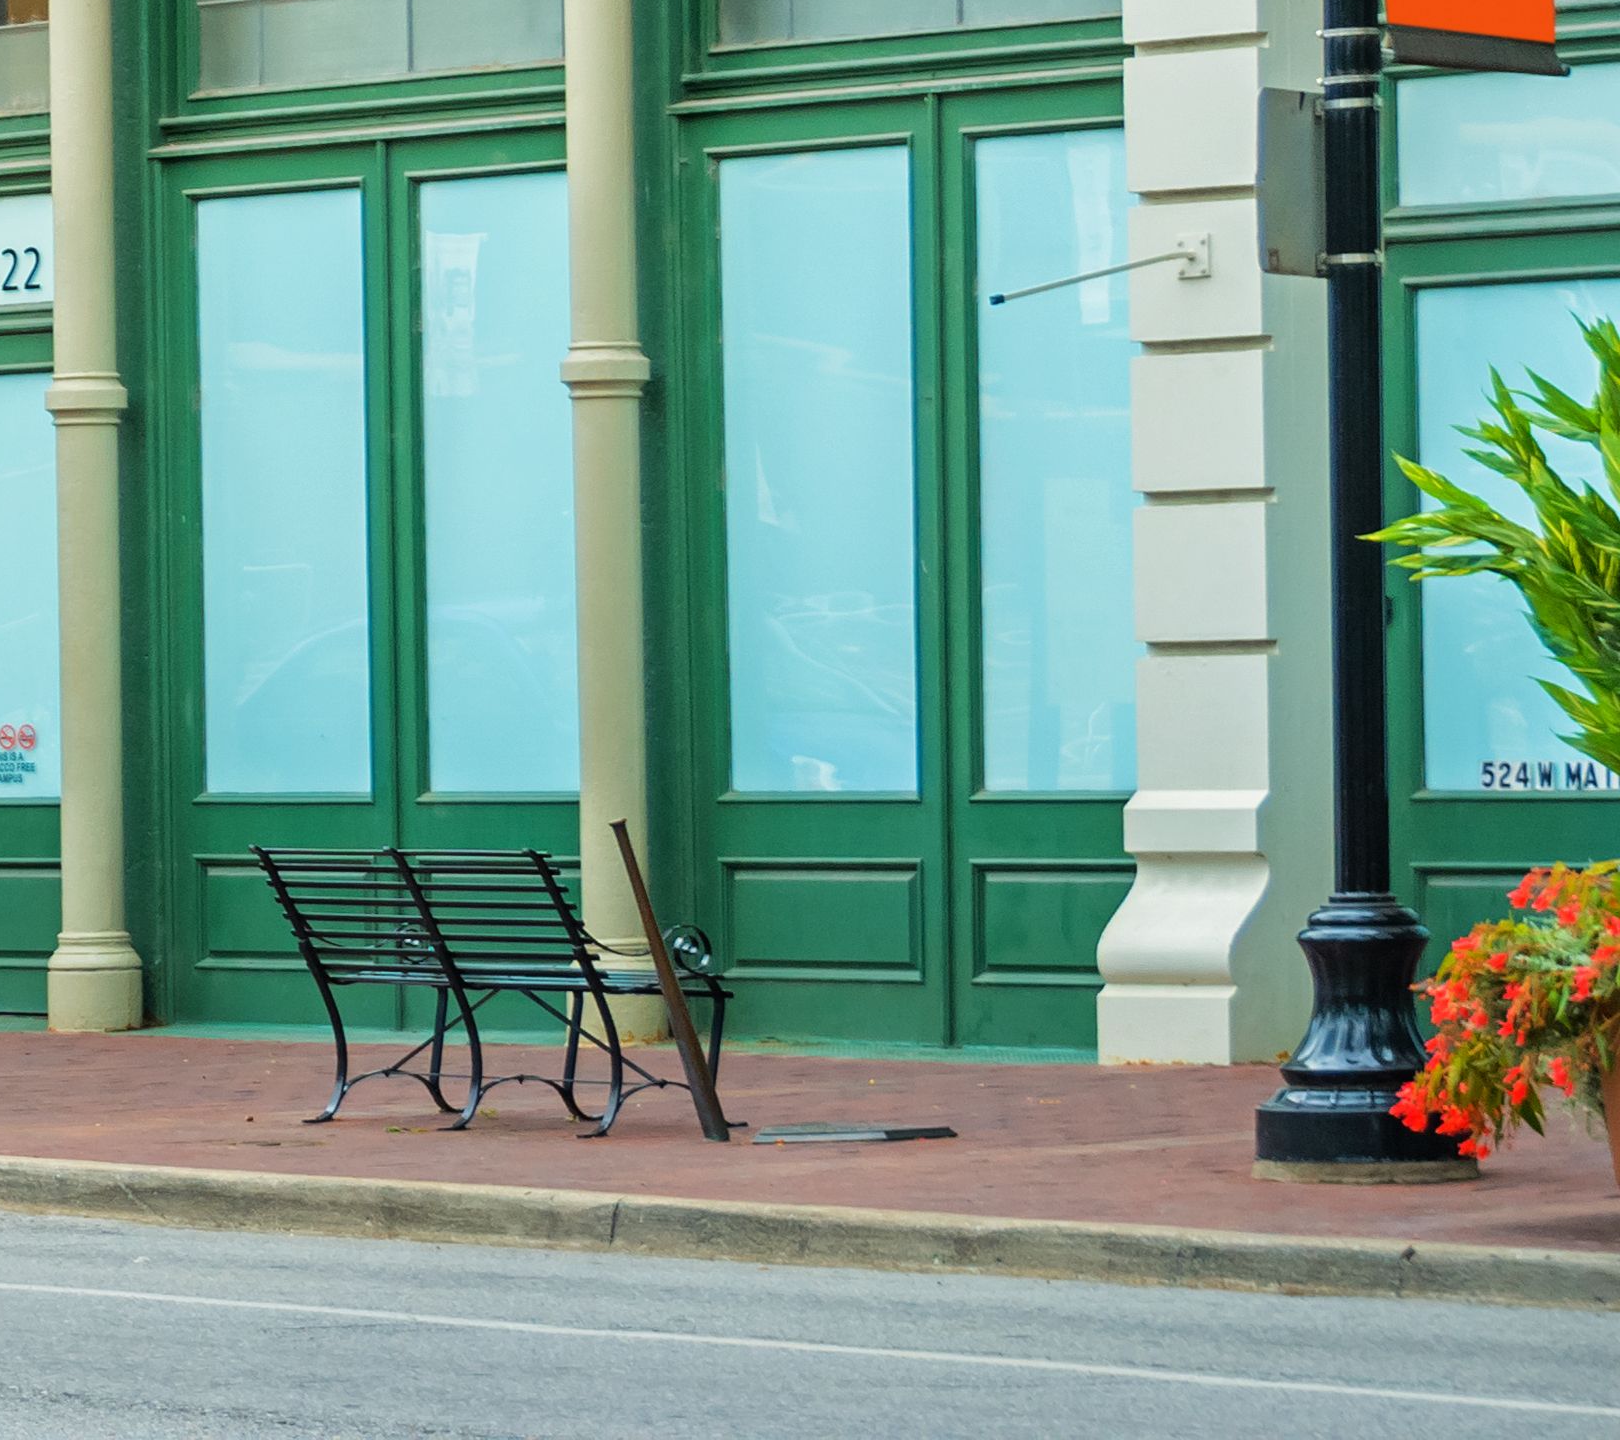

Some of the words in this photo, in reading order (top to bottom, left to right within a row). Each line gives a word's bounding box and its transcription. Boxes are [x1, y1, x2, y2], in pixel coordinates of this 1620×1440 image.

[16, 763, 35, 772] FREE
[1482, 762, 1530, 788] 524
[1538, 761, 1553, 788] W
[1566, 761, 1620, 790] MAI
